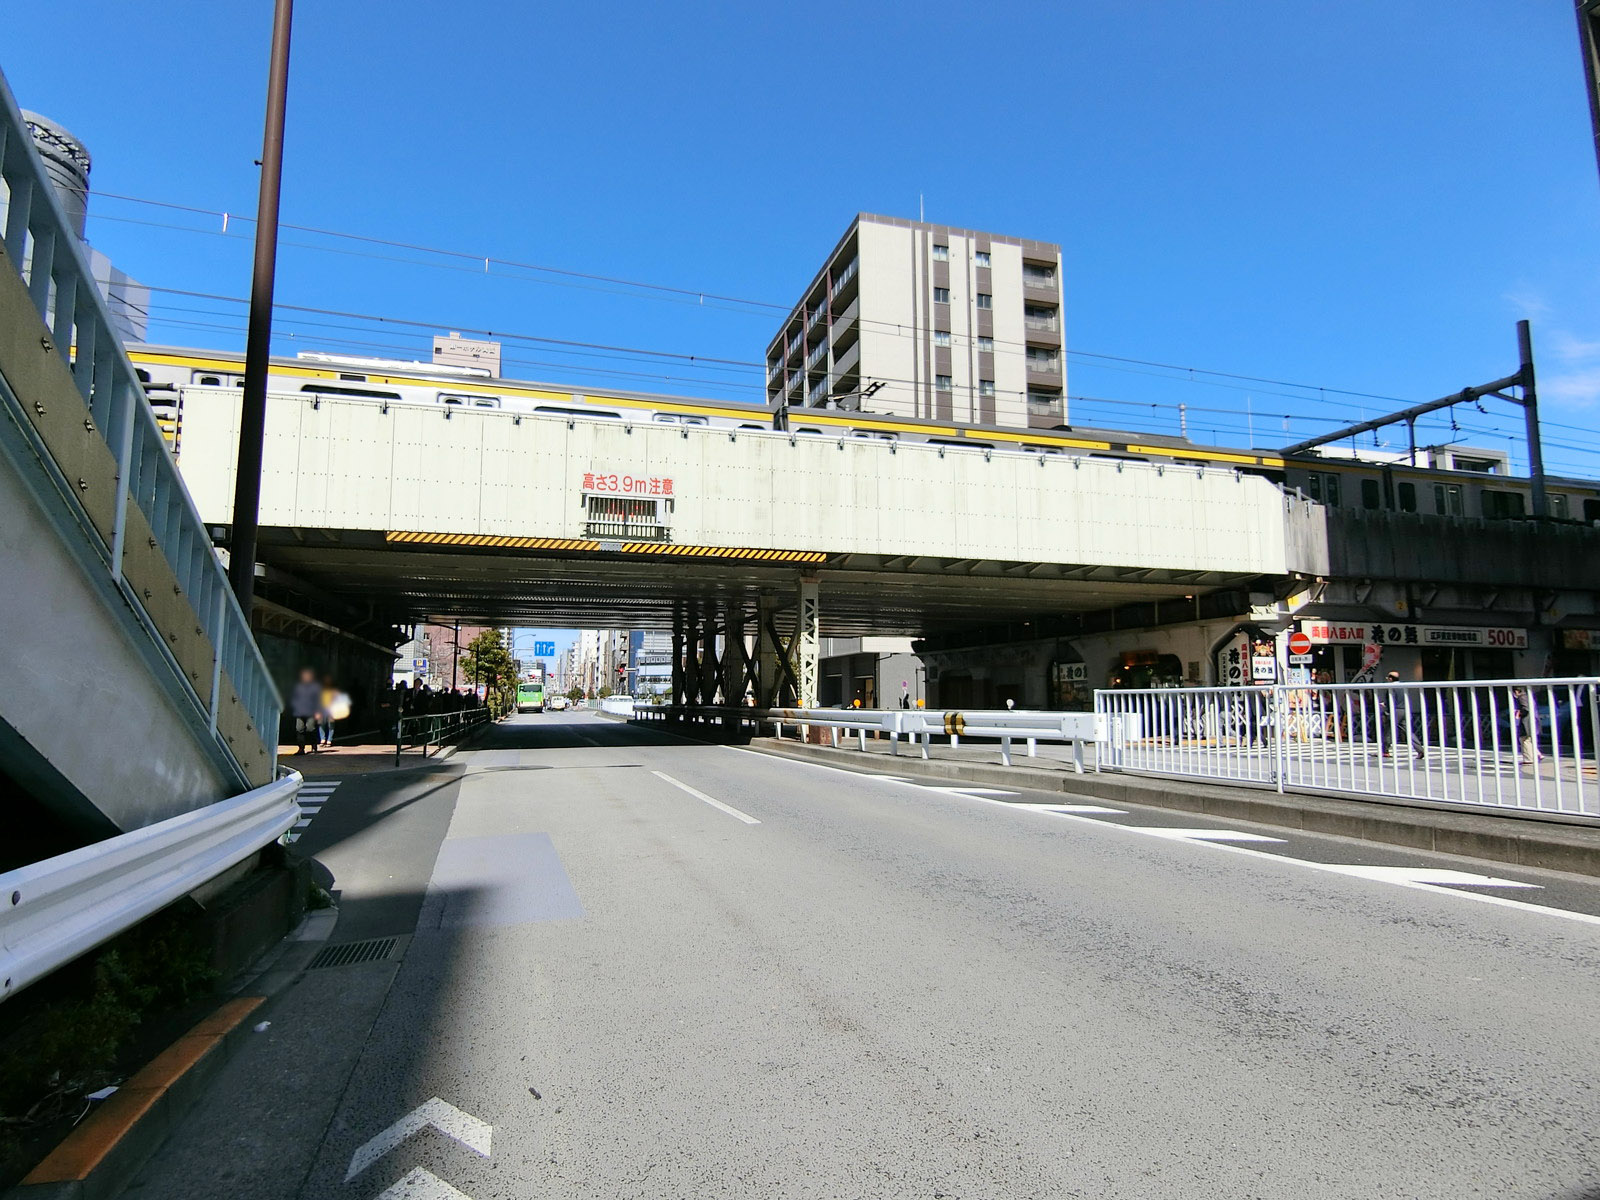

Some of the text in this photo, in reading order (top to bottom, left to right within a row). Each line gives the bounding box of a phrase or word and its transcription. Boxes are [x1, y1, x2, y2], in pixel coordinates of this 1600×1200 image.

[583, 473, 674, 495] 高さ3.9m注意
[1371, 624, 1418, 643] 花の舞
